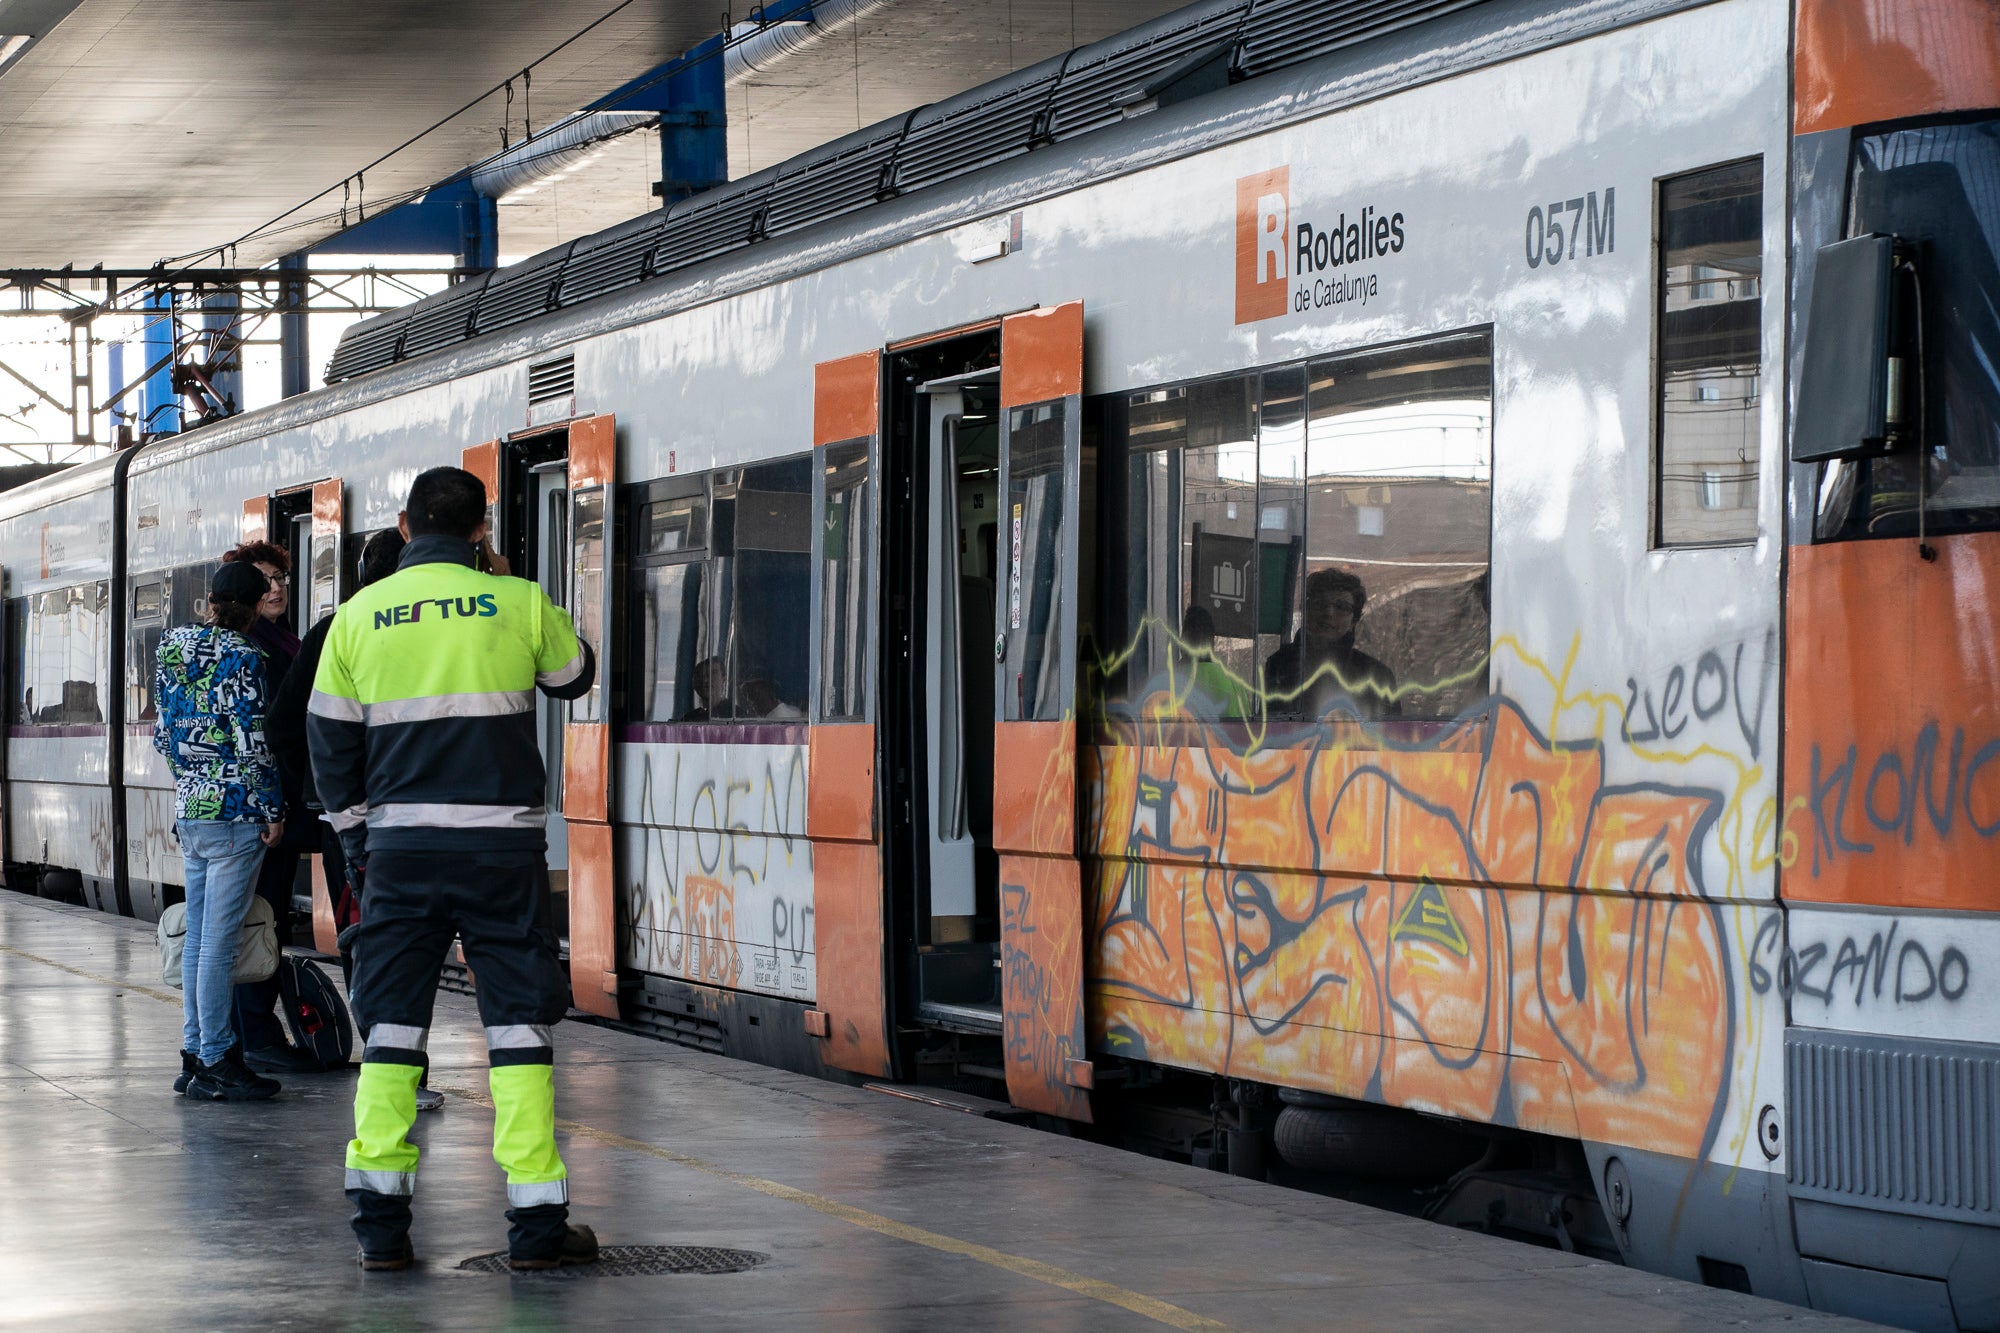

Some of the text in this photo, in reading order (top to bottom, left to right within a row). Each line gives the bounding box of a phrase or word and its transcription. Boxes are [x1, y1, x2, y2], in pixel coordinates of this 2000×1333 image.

[1296, 205, 1405, 276] Rodalies
[1525, 187, 1615, 269] 057M
[1294, 273, 1378, 313] de Catalunya
